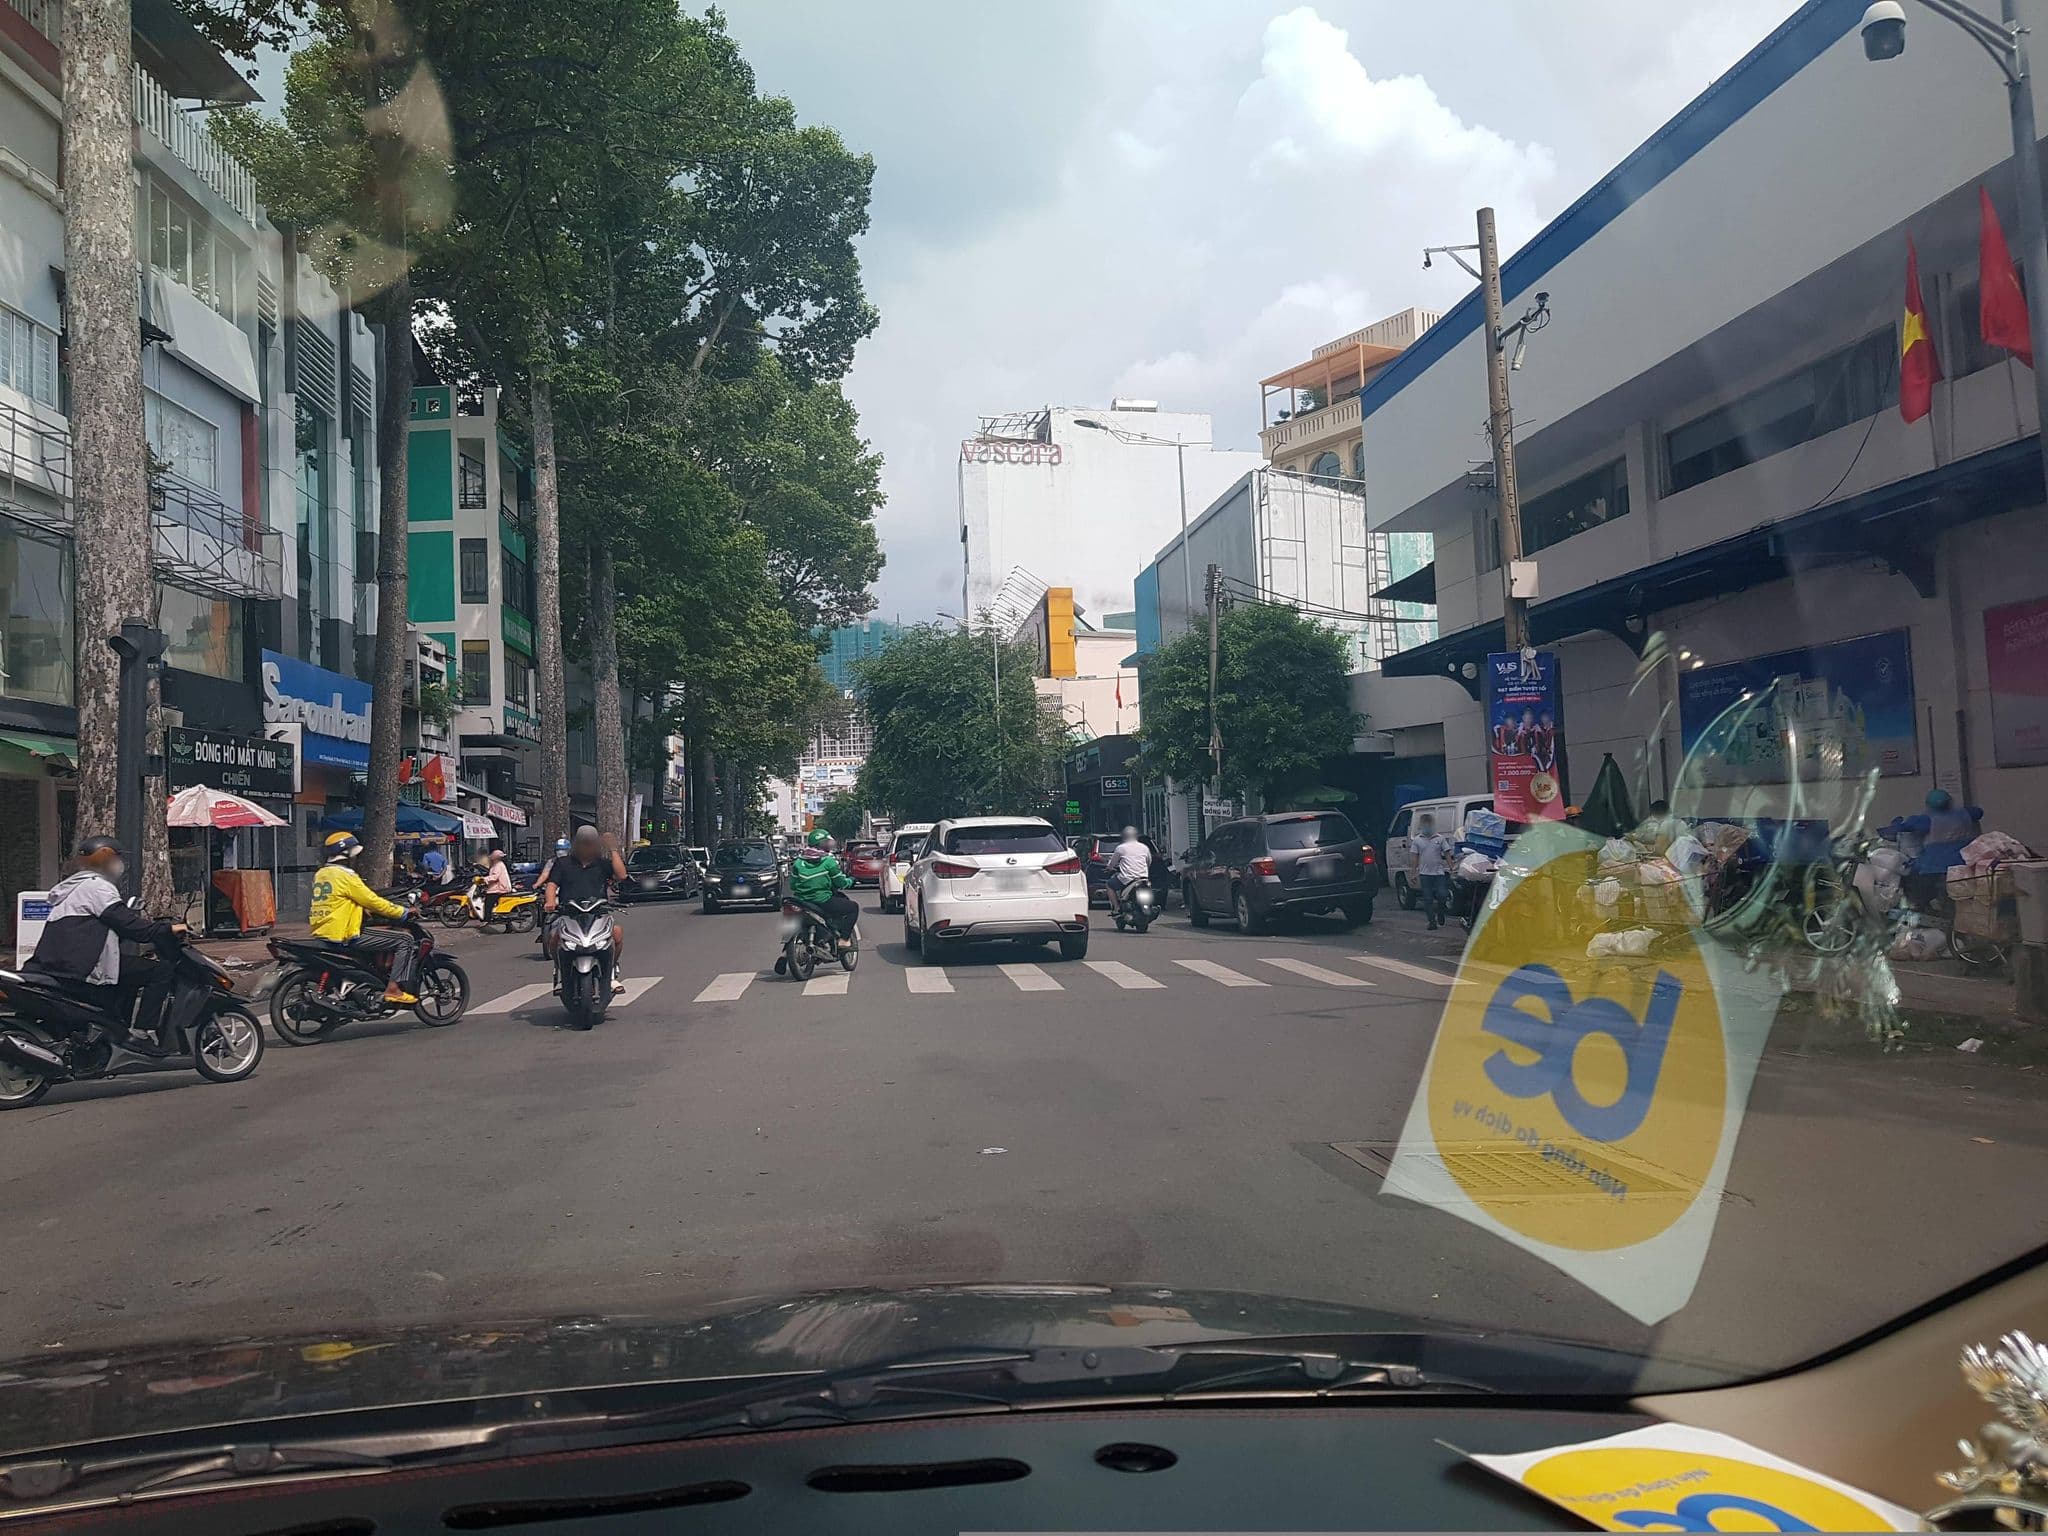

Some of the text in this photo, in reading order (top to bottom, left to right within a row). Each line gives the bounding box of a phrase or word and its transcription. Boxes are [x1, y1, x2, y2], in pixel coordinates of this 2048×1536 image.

[1496, 662, 1517, 674] VUS
[195, 735, 221, 763] ĐỒNG
[223, 738, 235, 764] HỒ
[257, 745, 276, 769] KÍNH
[222, 769, 251, 786] CHIẾN
[1105, 779, 1128, 788] GS25
